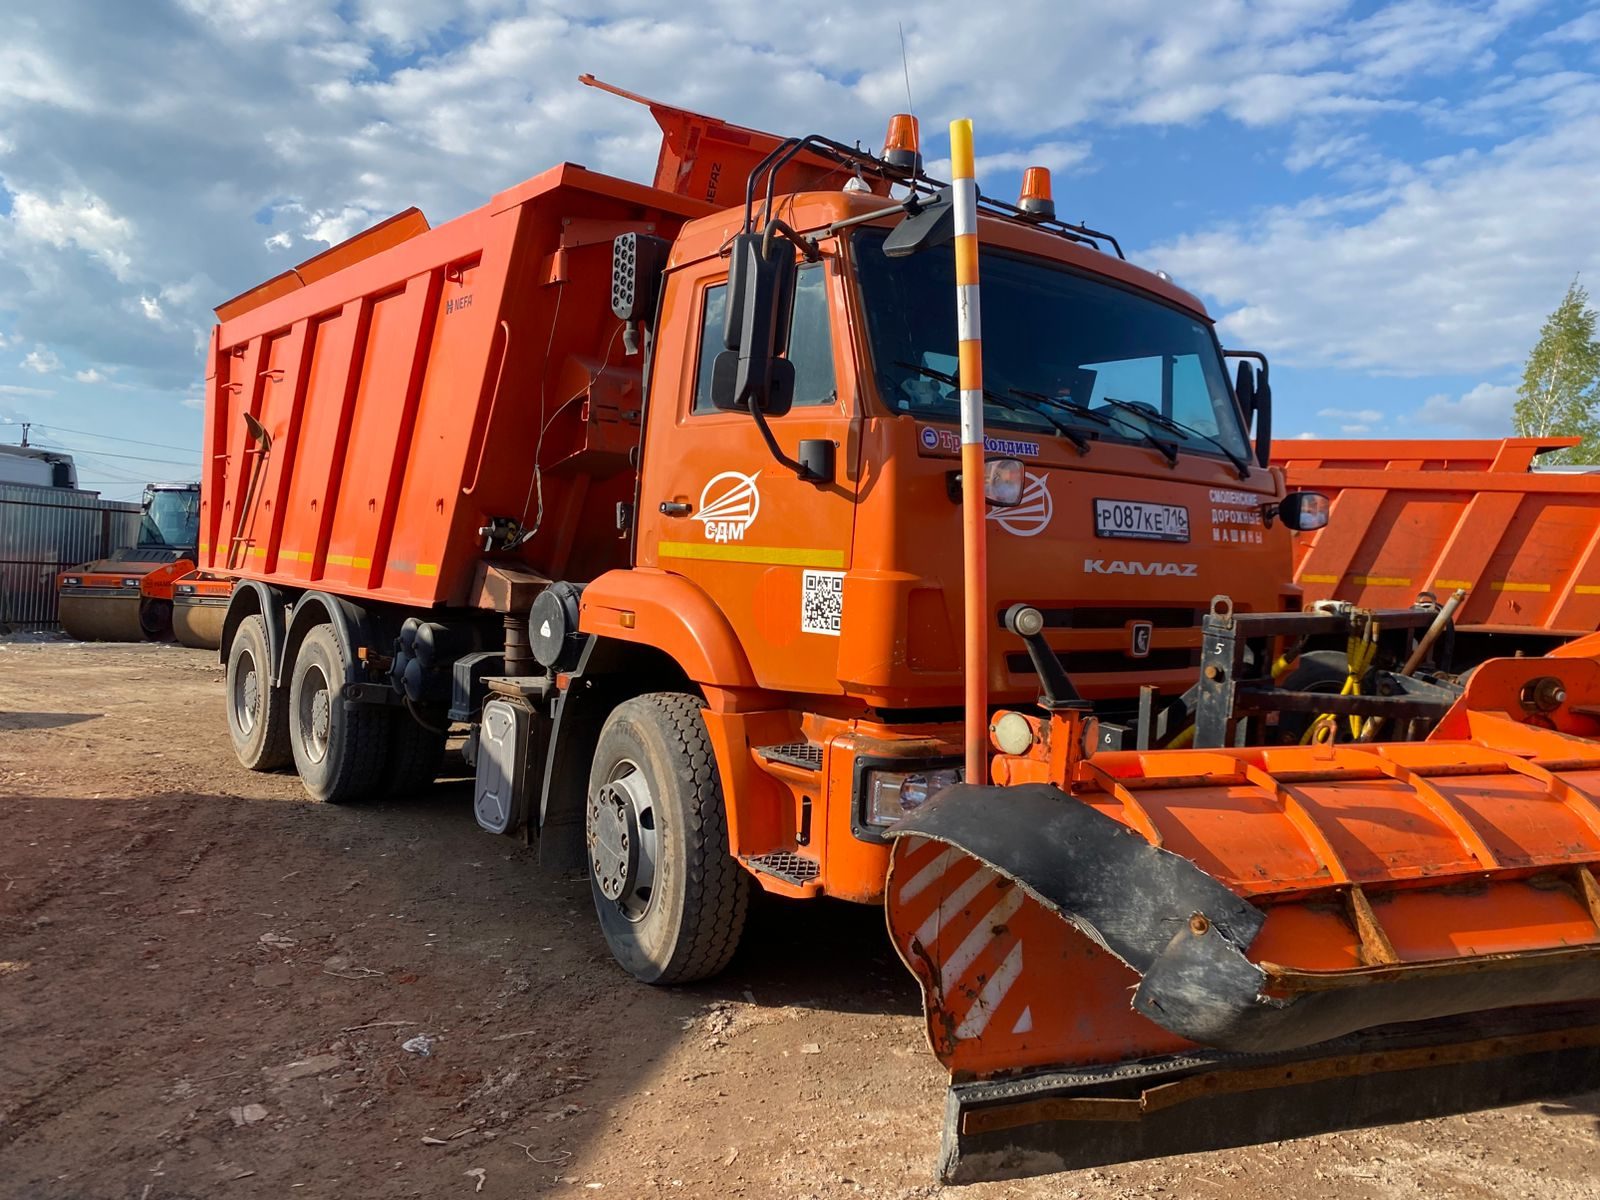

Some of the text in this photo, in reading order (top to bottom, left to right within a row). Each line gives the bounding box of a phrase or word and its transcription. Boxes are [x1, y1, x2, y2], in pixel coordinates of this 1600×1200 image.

[1211, 508, 1261, 525] ДОРОЖНЫЕ
[704, 520, 745, 544] СДМ
[1212, 527, 1263, 544] МАШИНЫ
[1083, 559, 1198, 576] KAMAZ
[1213, 642, 1225, 655] 5
[1104, 733, 1112, 744] 6
